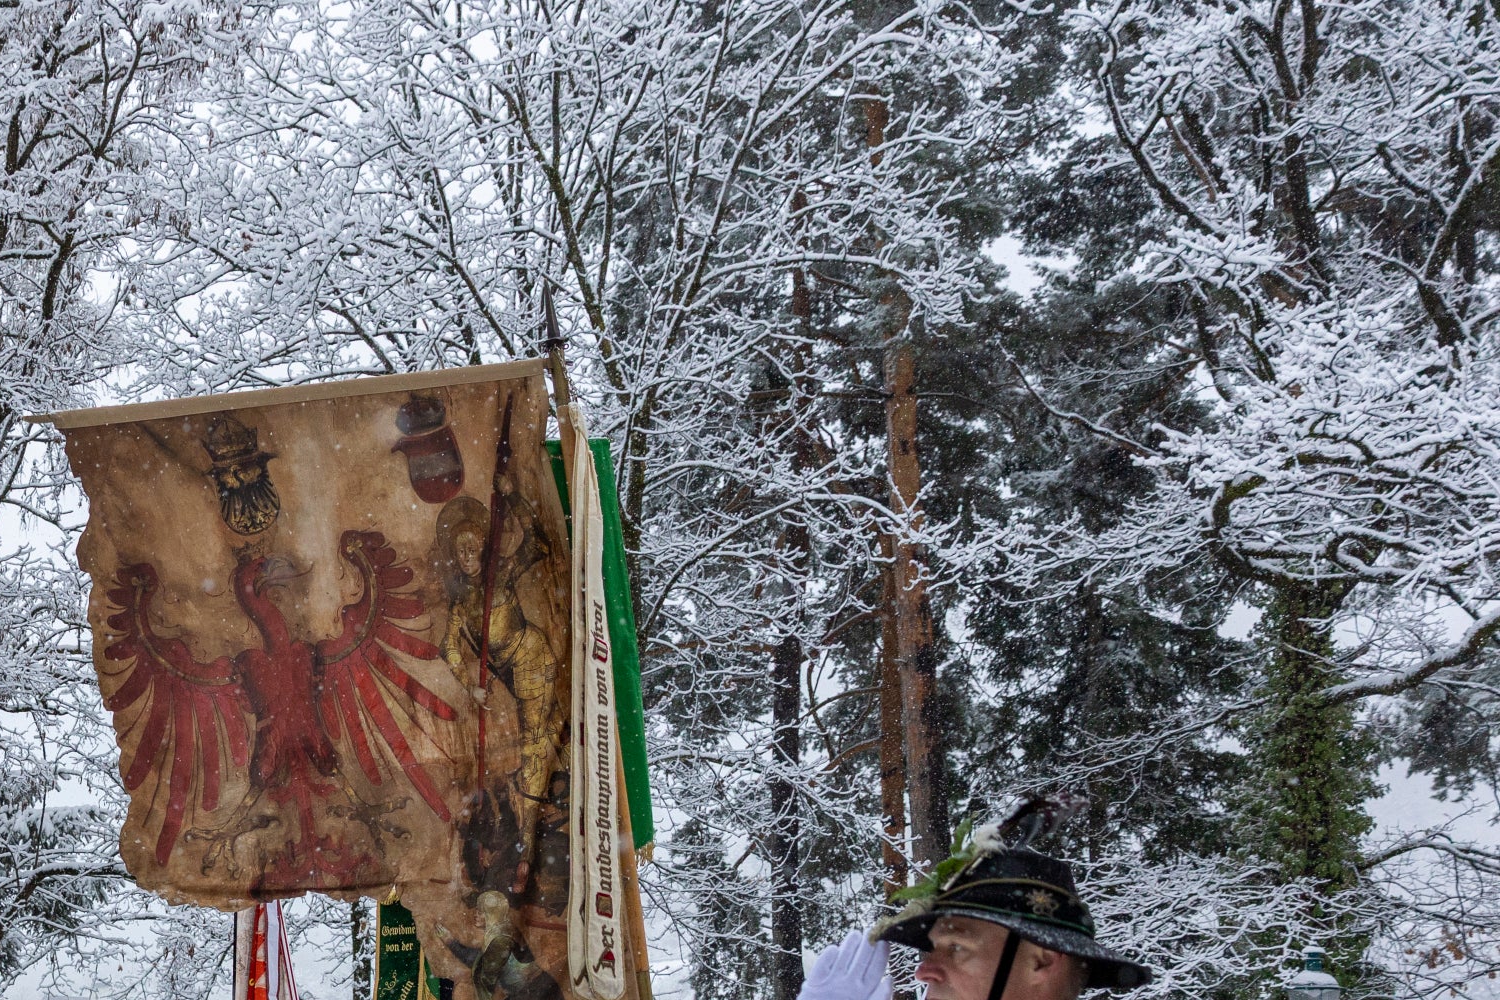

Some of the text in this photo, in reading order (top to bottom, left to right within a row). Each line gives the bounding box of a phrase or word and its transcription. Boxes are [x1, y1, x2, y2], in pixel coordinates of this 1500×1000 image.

[591, 600, 616, 978] Der Landeshauptmann von Tirol
[381, 925, 416, 936] Gewidme
[385, 941, 414, 952] von der
